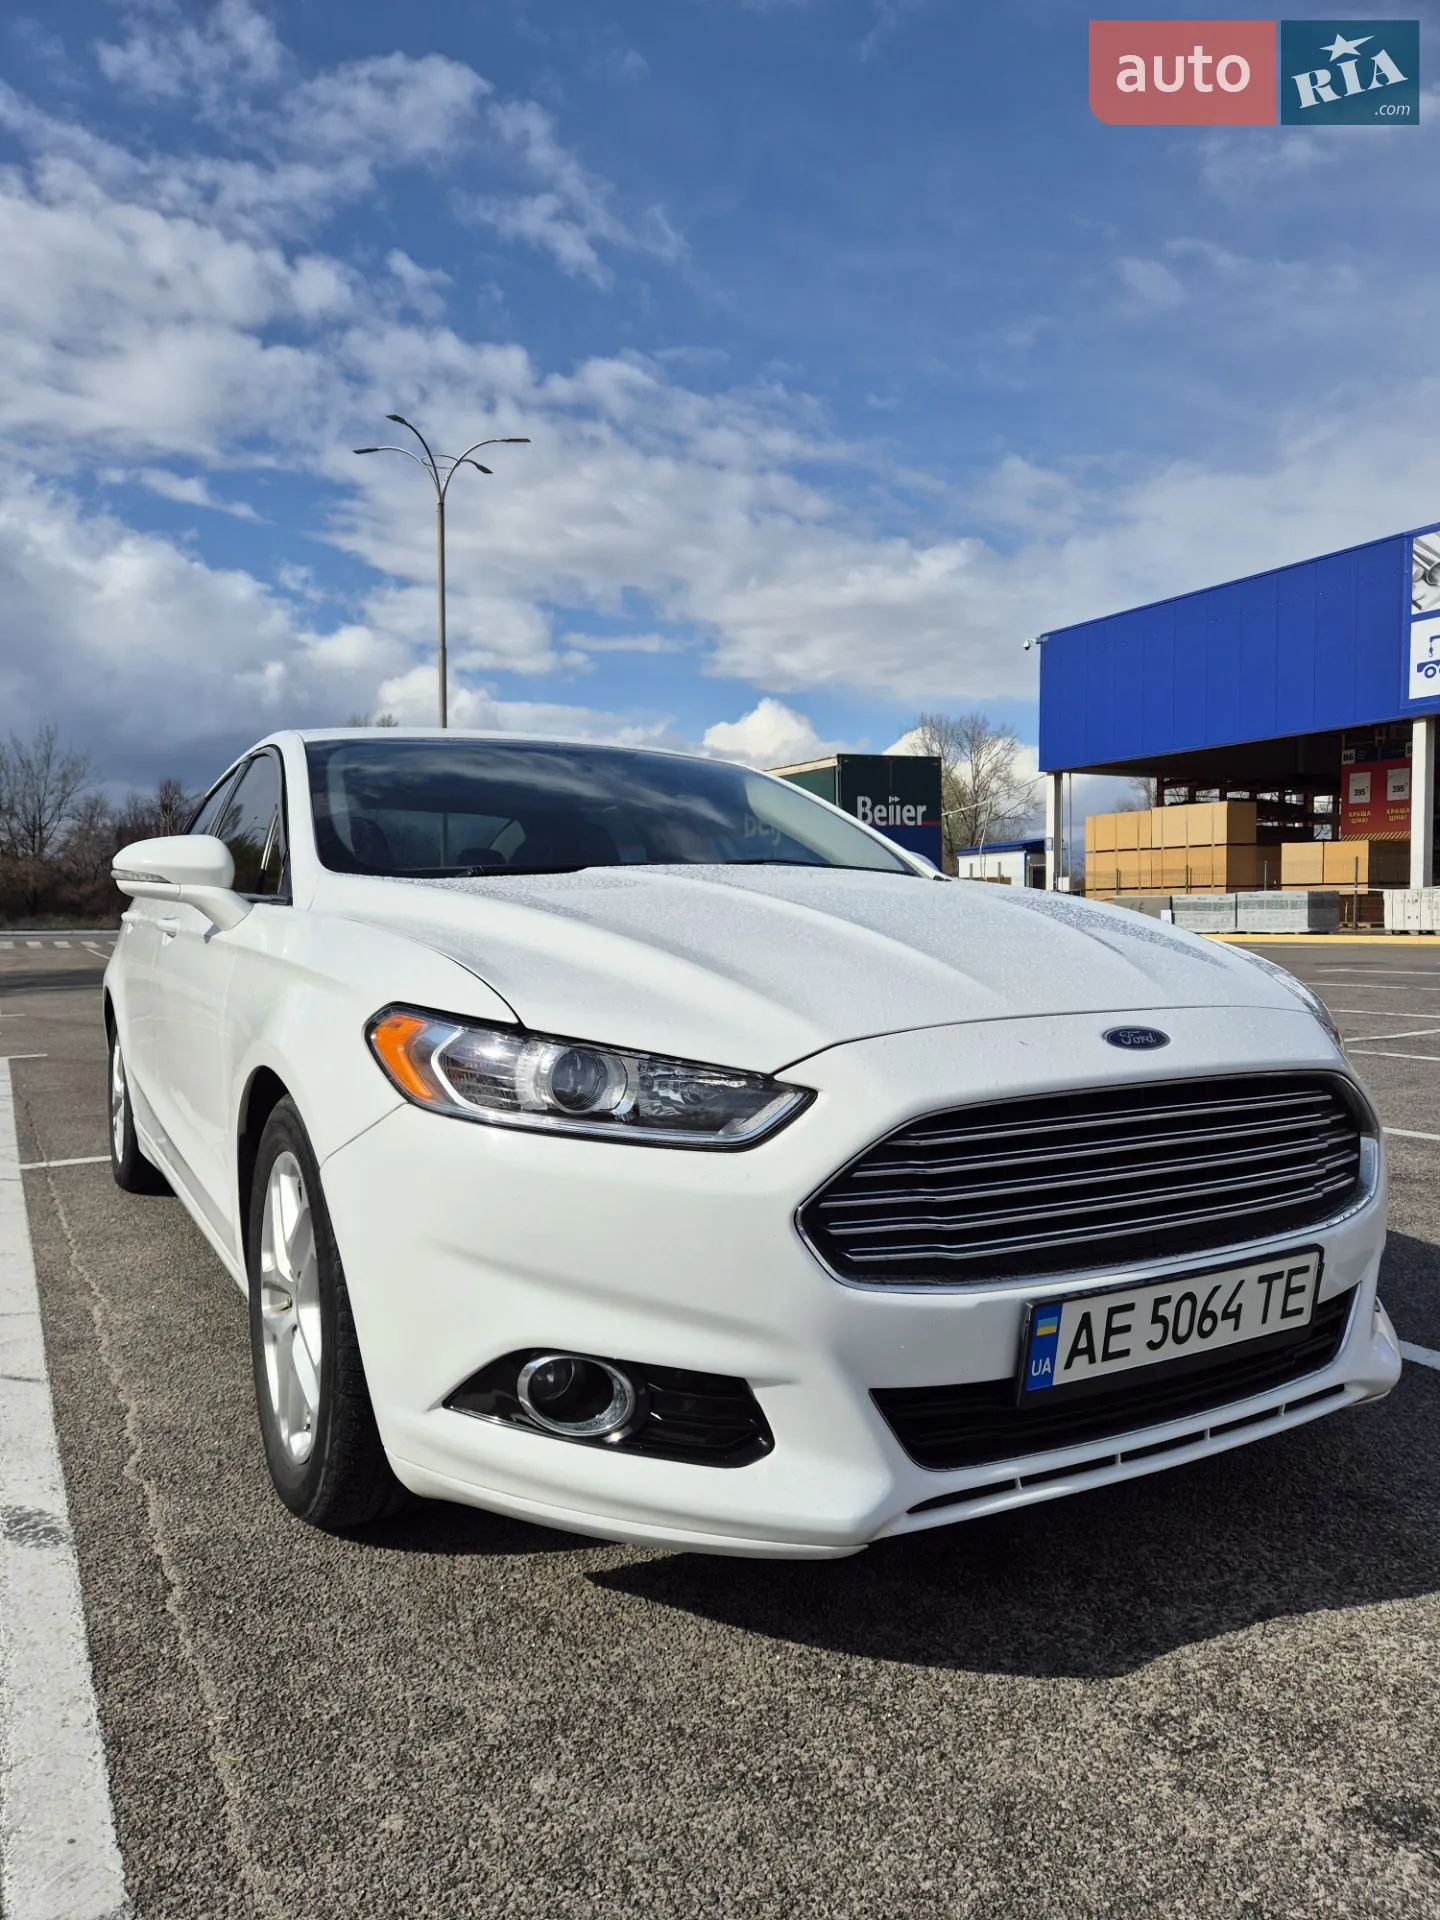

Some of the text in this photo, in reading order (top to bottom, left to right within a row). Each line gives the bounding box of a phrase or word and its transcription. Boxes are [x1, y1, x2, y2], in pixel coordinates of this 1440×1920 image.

[1119, 1030, 1155, 1045] Ford
[1063, 1264, 1311, 1370] AE 5064 TE
[1031, 1359, 1052, 1377] UA
